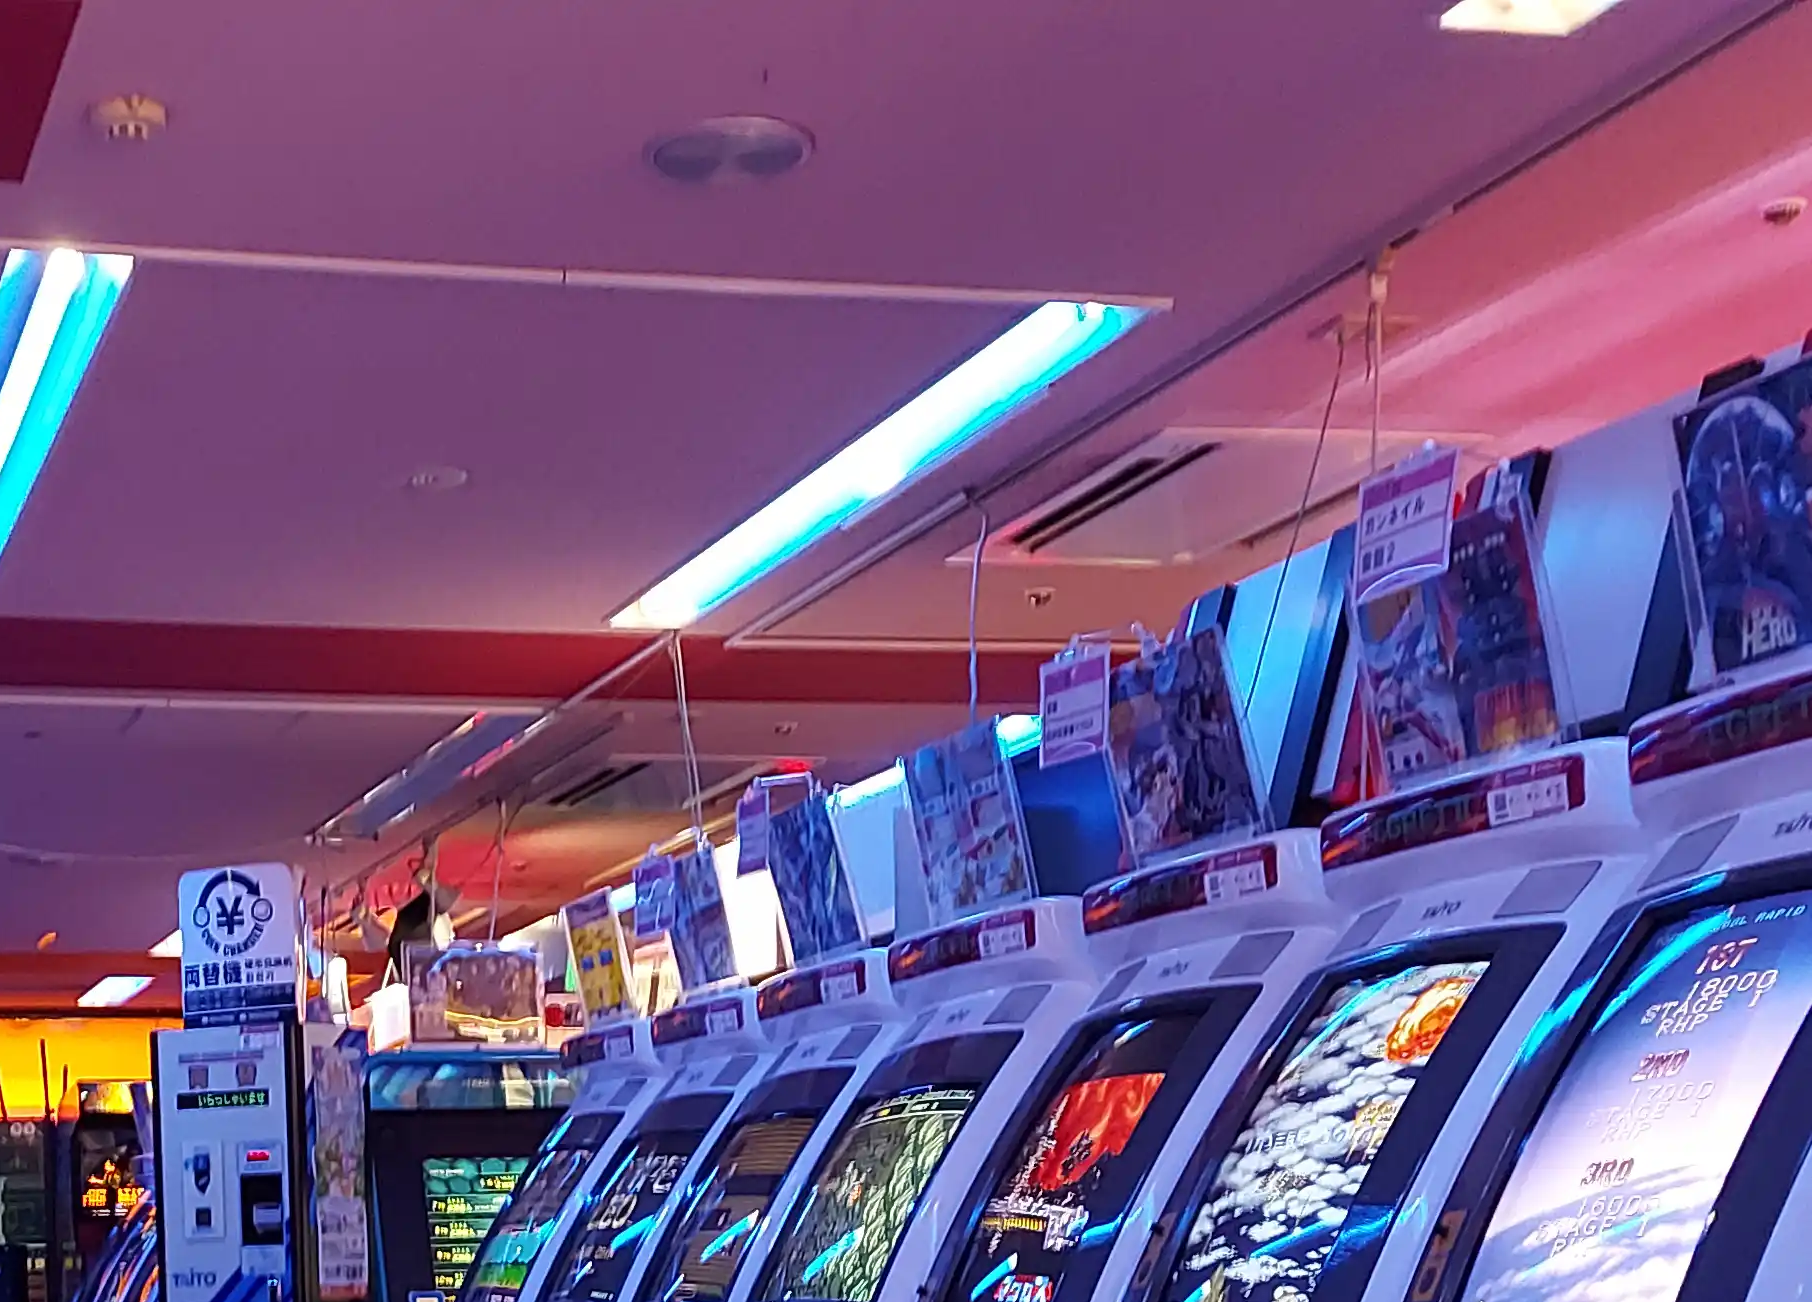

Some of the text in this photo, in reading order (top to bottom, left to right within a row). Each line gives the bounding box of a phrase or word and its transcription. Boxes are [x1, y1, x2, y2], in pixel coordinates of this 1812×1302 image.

[1742, 615, 1797, 660] HERO
[1754, 904, 1806, 923] RAPID
[1695, 937, 1758, 975] 1ST
[1684, 969, 1779, 1001] 18000
[1641, 993, 1729, 1025] STAGE
[1655, 1013, 1709, 1039] RHP
[1630, 1048, 1690, 1083] 2ND
[1631, 1080, 1716, 1108] 17000
[1586, 1101, 1671, 1128] STAGE
[1579, 1157, 1635, 1187] 3RD
[172, 1266, 217, 1288] TAITO
